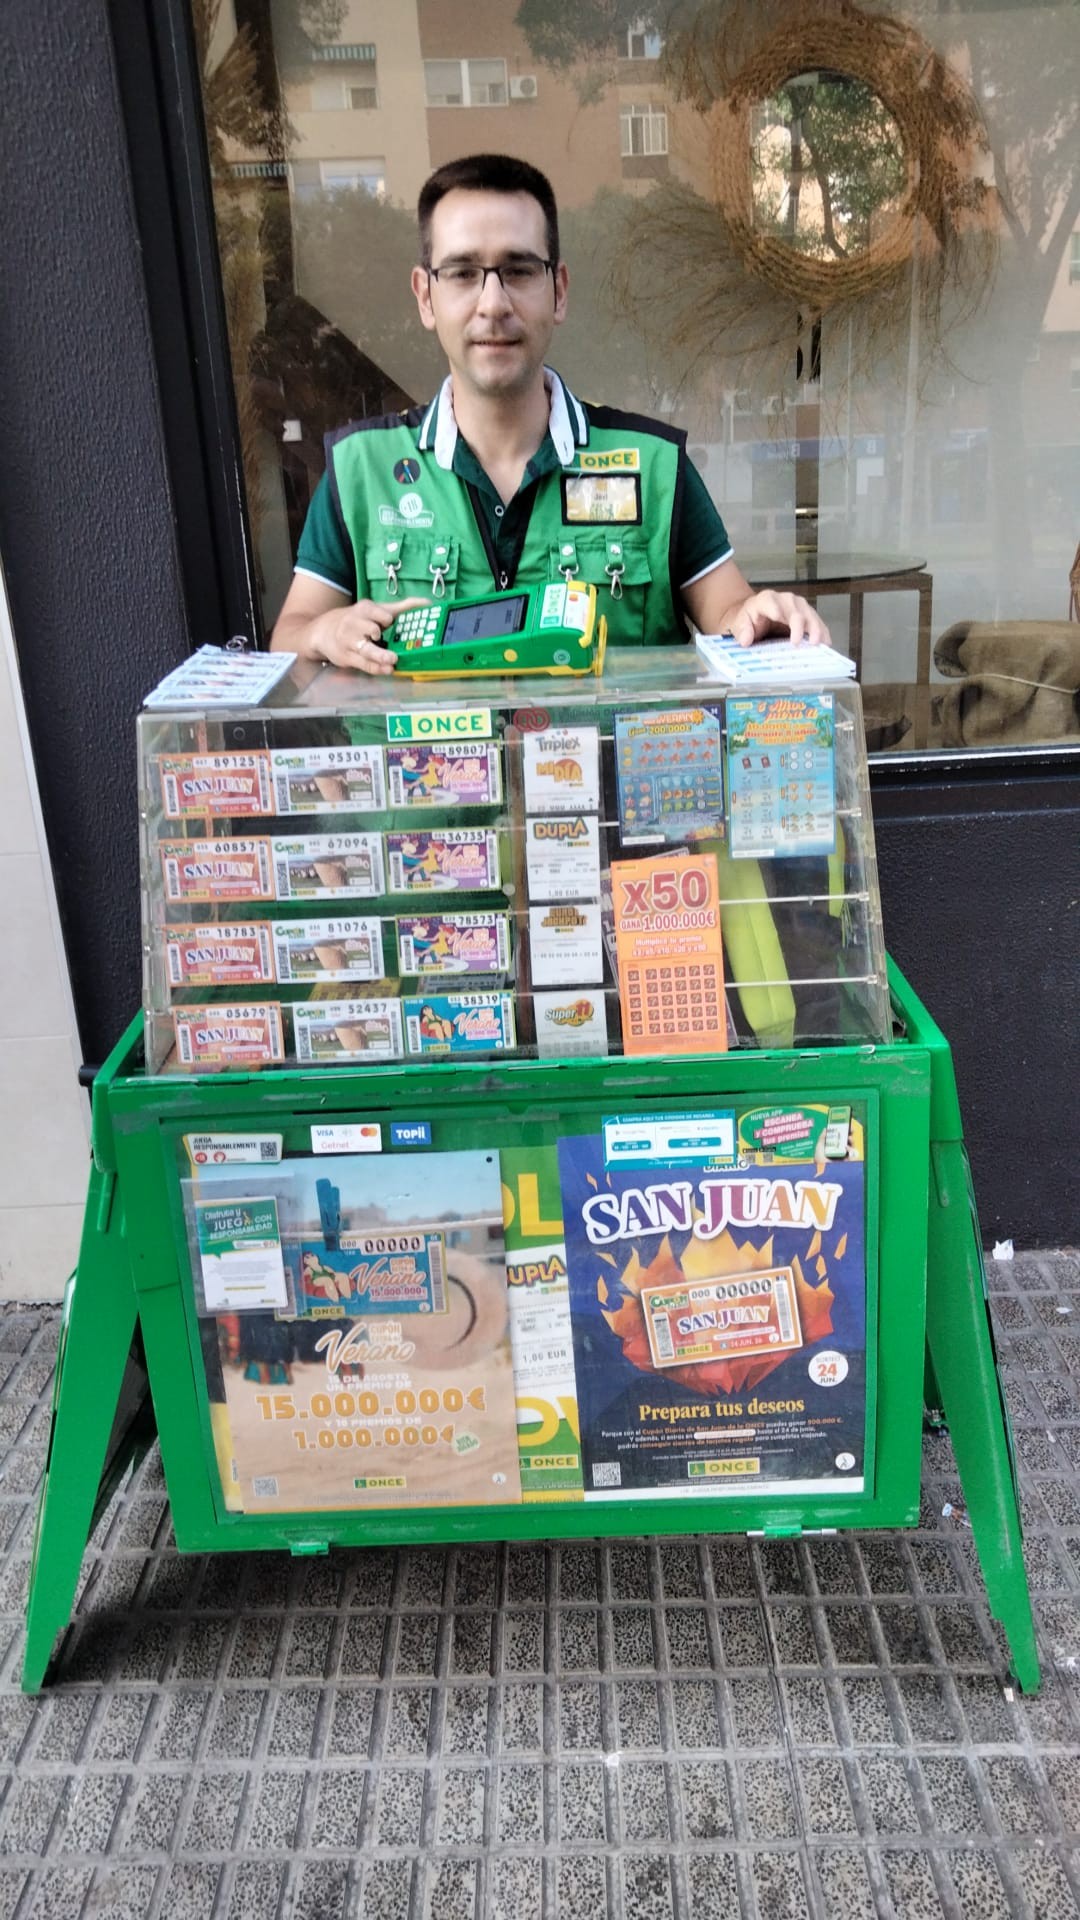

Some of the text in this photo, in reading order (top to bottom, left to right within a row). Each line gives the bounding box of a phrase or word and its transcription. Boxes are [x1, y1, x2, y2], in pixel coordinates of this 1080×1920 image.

[584, 453, 634, 467] ONCE
[417, 715, 483, 733] ONCE
[448, 744, 484, 756] 89807
[535, 736, 581, 753] Triplex
[214, 757, 255, 767] 89125
[328, 752, 369, 763] 95301
[183, 777, 254, 796] SAN JUAN
[533, 817, 589, 840] DUPLA
[328, 838, 369, 849] 67094
[448, 831, 483, 842] 36735
[215, 842, 255, 853] 60857
[184, 861, 254, 880] SAN JUAN
[621, 868, 709, 914] x50
[328, 922, 367, 933] 81076
[458, 915, 494, 926] 78573
[642, 911, 715, 931] 1.000.000€
[217, 926, 256, 937] 18783
[186, 946, 255, 965] SAN JUAN
[463, 994, 498, 1006] 38319
[226, 1007, 266, 1018] 05679
[348, 1003, 388, 1014] 52437
[544, 1008, 576, 1021] Super
[196, 1026, 264, 1045] SAN JUAN
[761, 1119, 814, 1136] COMPRUEBA
[193, 1142, 257, 1150] RESPONSABLEMENTE
[585, 1183, 839, 1240] SAN JUAN
[255, 1214, 272, 1224] CON
[364, 1237, 421, 1253] 00000
[350, 1258, 426, 1294] Verano
[507, 1254, 566, 1287] UPLA
[691, 1289, 710, 1299] 000
[715, 1279, 772, 1300] 00000
[314, 1307, 344, 1316] ONCE
[678, 1310, 717, 1335] SAN
[718, 1306, 769, 1328] JUAN
[315, 1322, 415, 1373] Verano
[686, 1344, 711, 1354] ONCE
[548, 1350, 567, 1360] EUR
[817, 1363, 837, 1377] 24
[256, 1386, 487, 1420] 15.000.000€
[639, 1398, 805, 1424] Prepara tus deseos
[294, 1424, 454, 1449] 1.000.000€
[534, 1457, 574, 1466] ONCE
[709, 1461, 754, 1472] ONCE
[369, 1478, 404, 1487] ONCE
